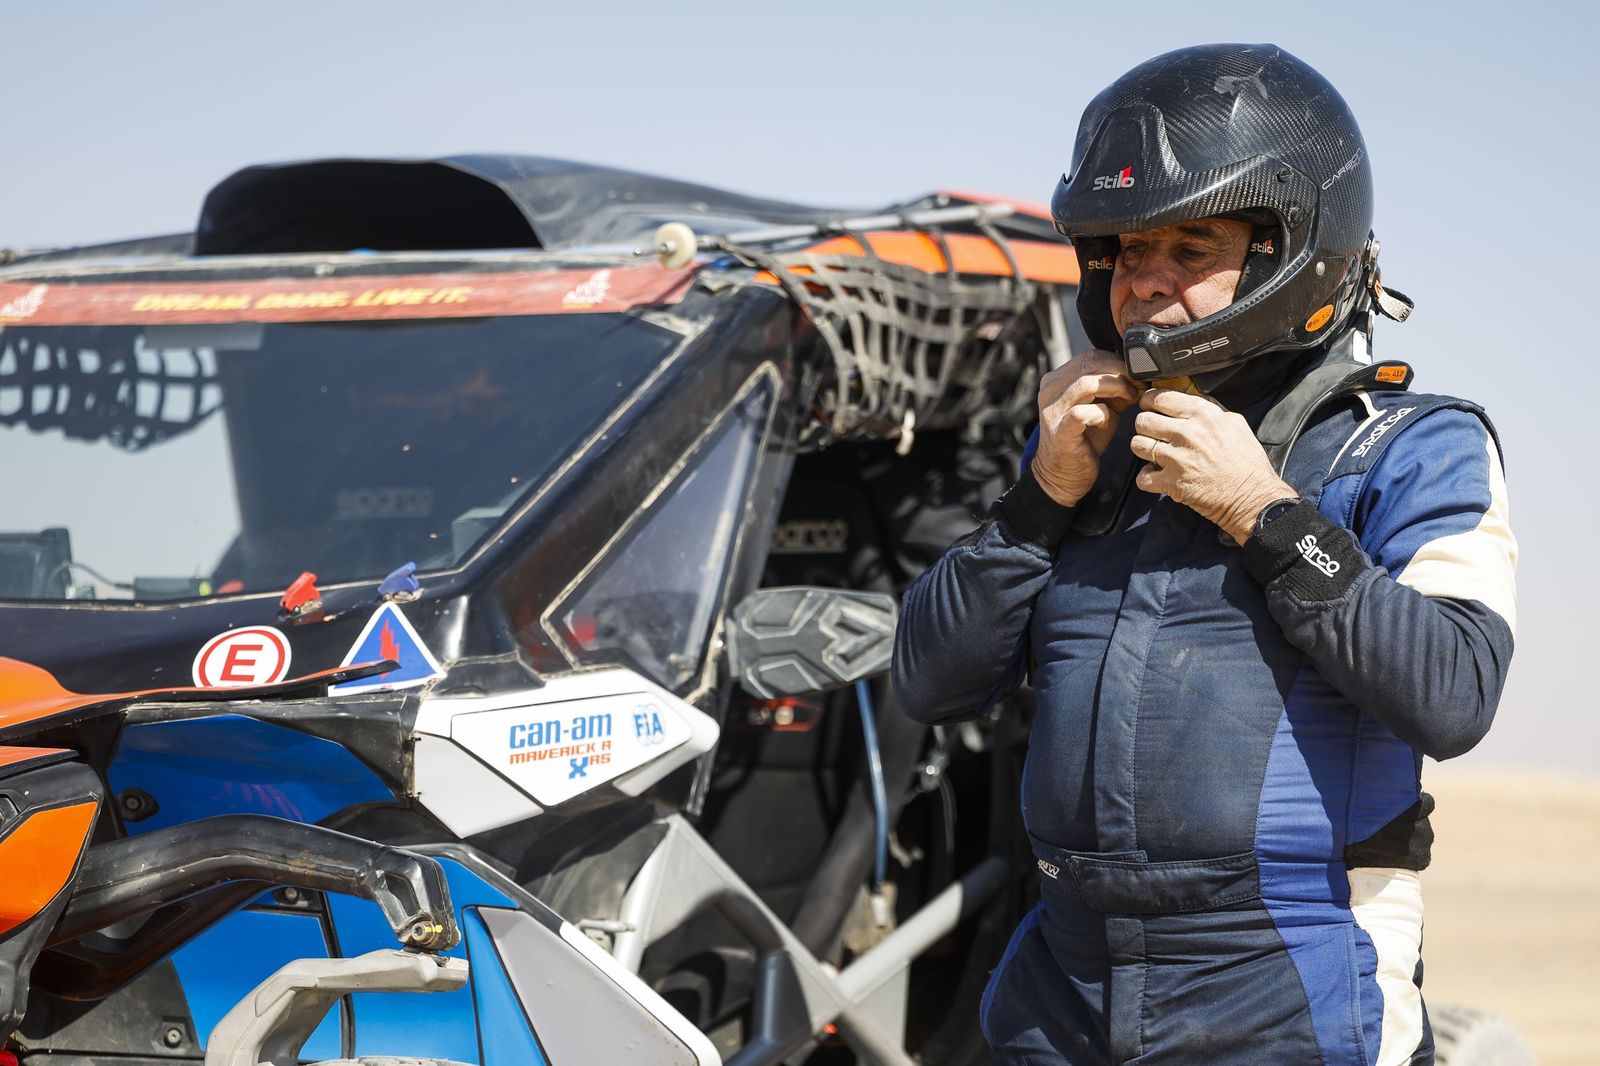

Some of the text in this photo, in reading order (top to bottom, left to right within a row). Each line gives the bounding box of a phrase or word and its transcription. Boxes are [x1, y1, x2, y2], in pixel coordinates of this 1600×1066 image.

[352, 287, 431, 306] LIVE
[1171, 336, 1230, 361] DES
[219, 644, 264, 682] E
[509, 742, 596, 765] MAVERICK
